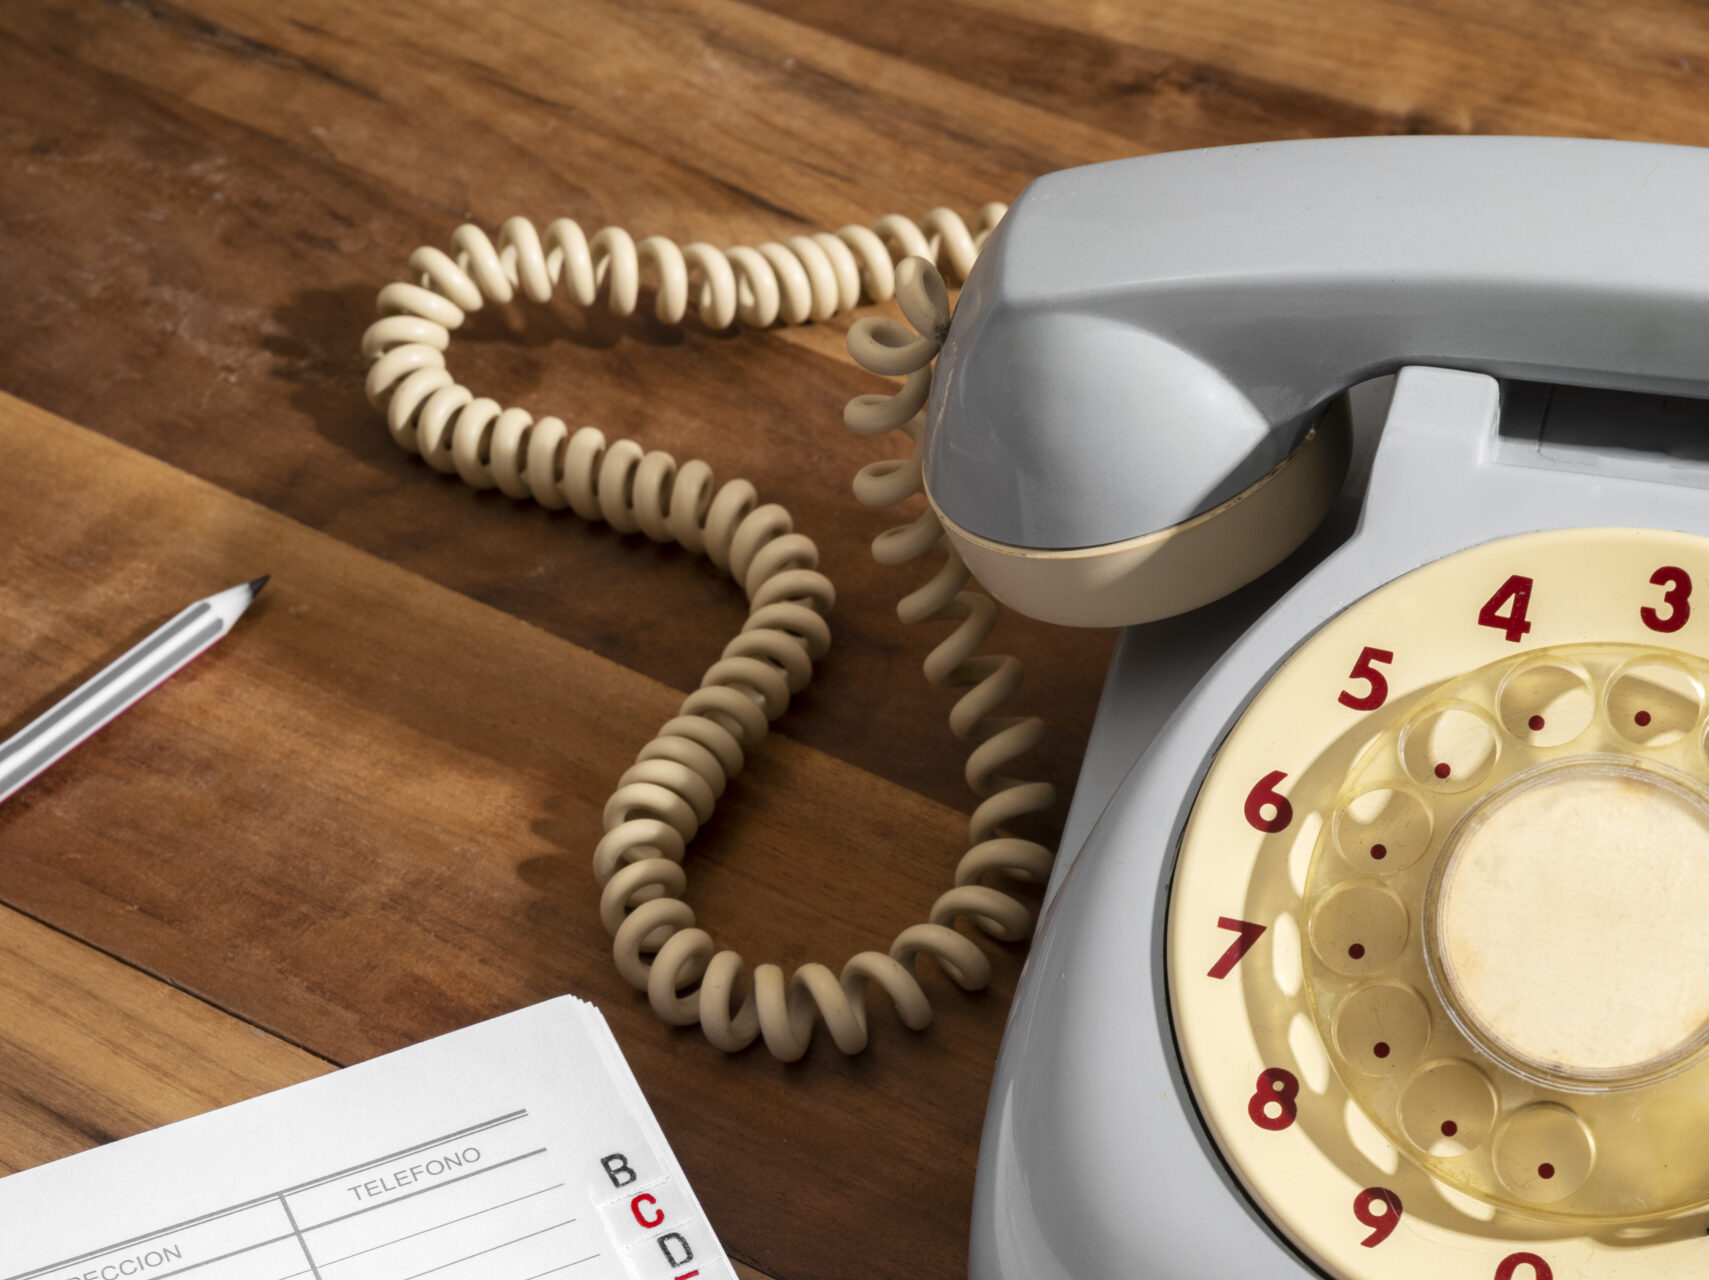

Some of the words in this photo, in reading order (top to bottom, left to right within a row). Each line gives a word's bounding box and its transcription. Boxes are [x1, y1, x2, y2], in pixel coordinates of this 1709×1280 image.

[1477, 575, 1533, 643] 4
[1640, 566, 1692, 633] 3
[1337, 646, 1394, 711] 5
[1243, 770, 1292, 834] 6
[1206, 916, 1267, 980] 7
[1247, 1067, 1299, 1131] 8
[346, 1146, 482, 1202] TELEFONO
[600, 1152, 638, 1189] B
[630, 1192, 665, 1229] C
[1352, 1186, 1402, 1249] 9
[656, 1231, 695, 1269] D
